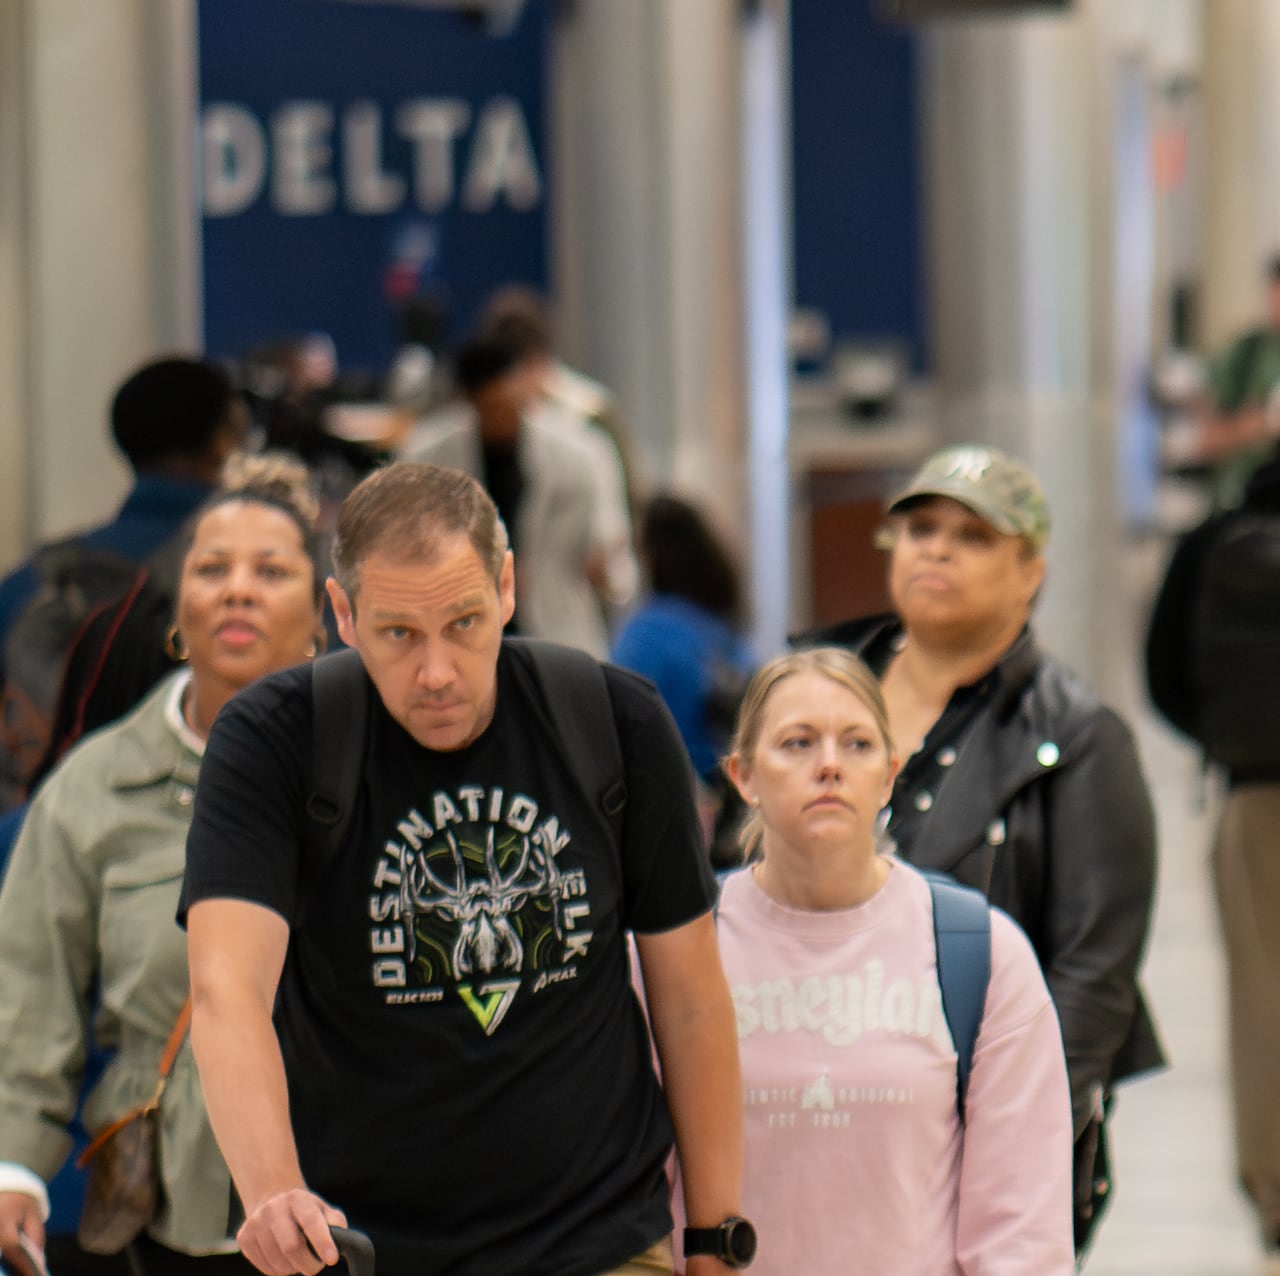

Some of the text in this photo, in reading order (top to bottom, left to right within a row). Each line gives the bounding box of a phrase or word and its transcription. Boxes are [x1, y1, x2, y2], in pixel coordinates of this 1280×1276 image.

[202, 98, 541, 216] DELTA
[369, 786, 593, 987] DESTINATION ELK
[732, 957, 948, 1048] sneylan
